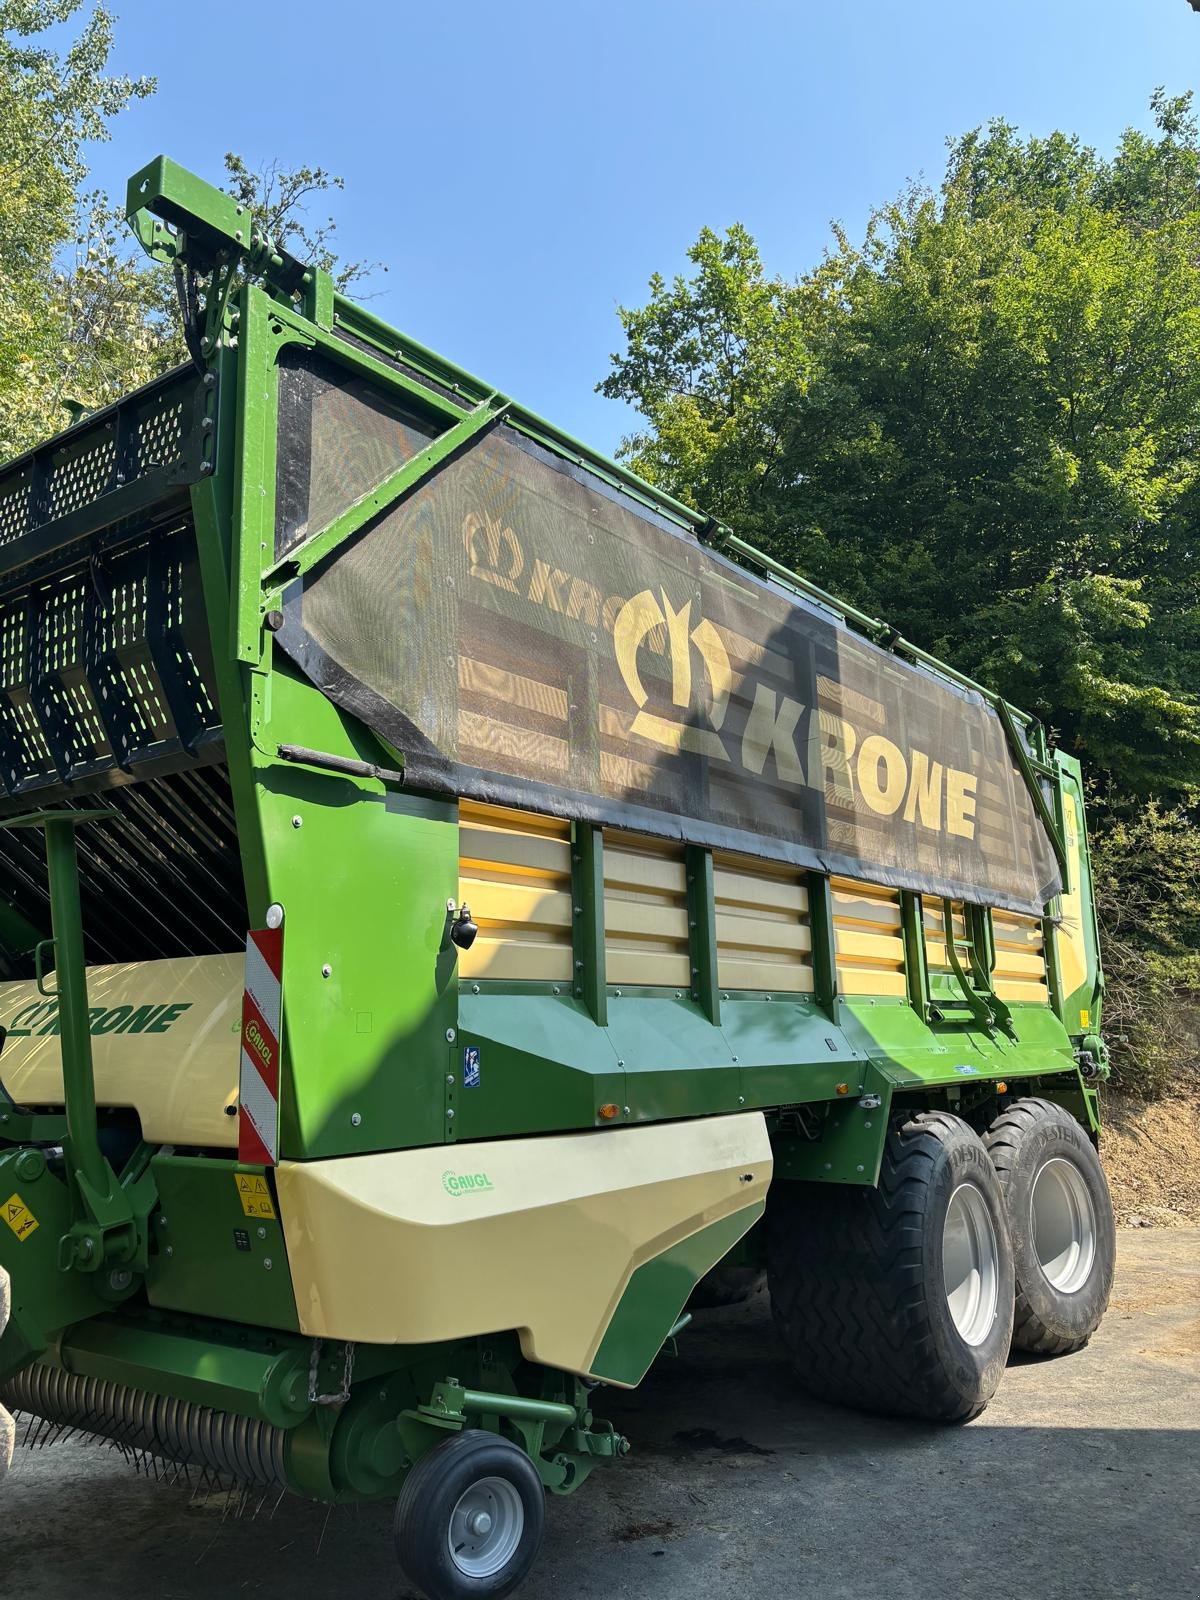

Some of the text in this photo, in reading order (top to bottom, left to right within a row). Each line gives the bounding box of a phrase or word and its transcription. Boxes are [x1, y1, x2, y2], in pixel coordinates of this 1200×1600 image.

[742, 682, 977, 840] KRONE
[249, 1026, 272, 1065] GAUGL
[448, 1173, 493, 1190] GAUGL
